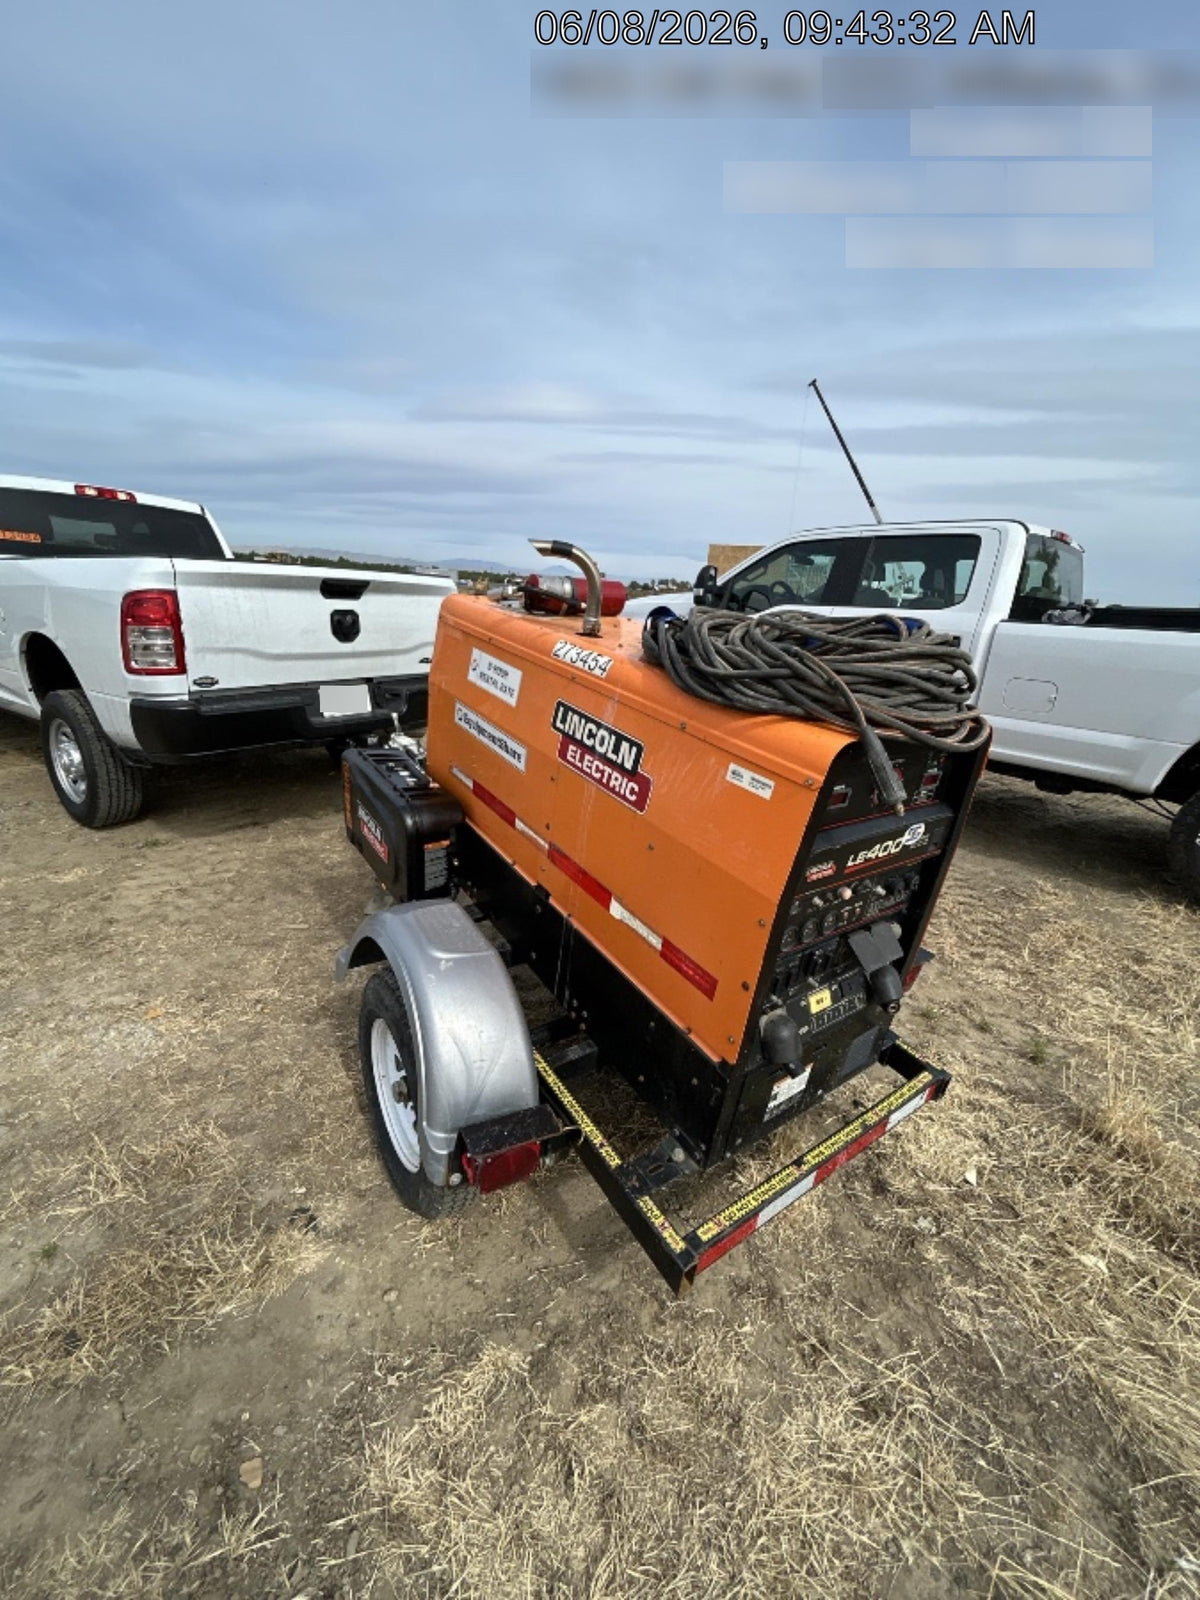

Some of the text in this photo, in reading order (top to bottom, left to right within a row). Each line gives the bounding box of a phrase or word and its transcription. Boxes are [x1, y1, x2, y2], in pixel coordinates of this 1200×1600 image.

[553, 641, 612, 676] 273454
[556, 706, 637, 770] LINCOLN
[567, 745, 639, 802] ELECTRIC
